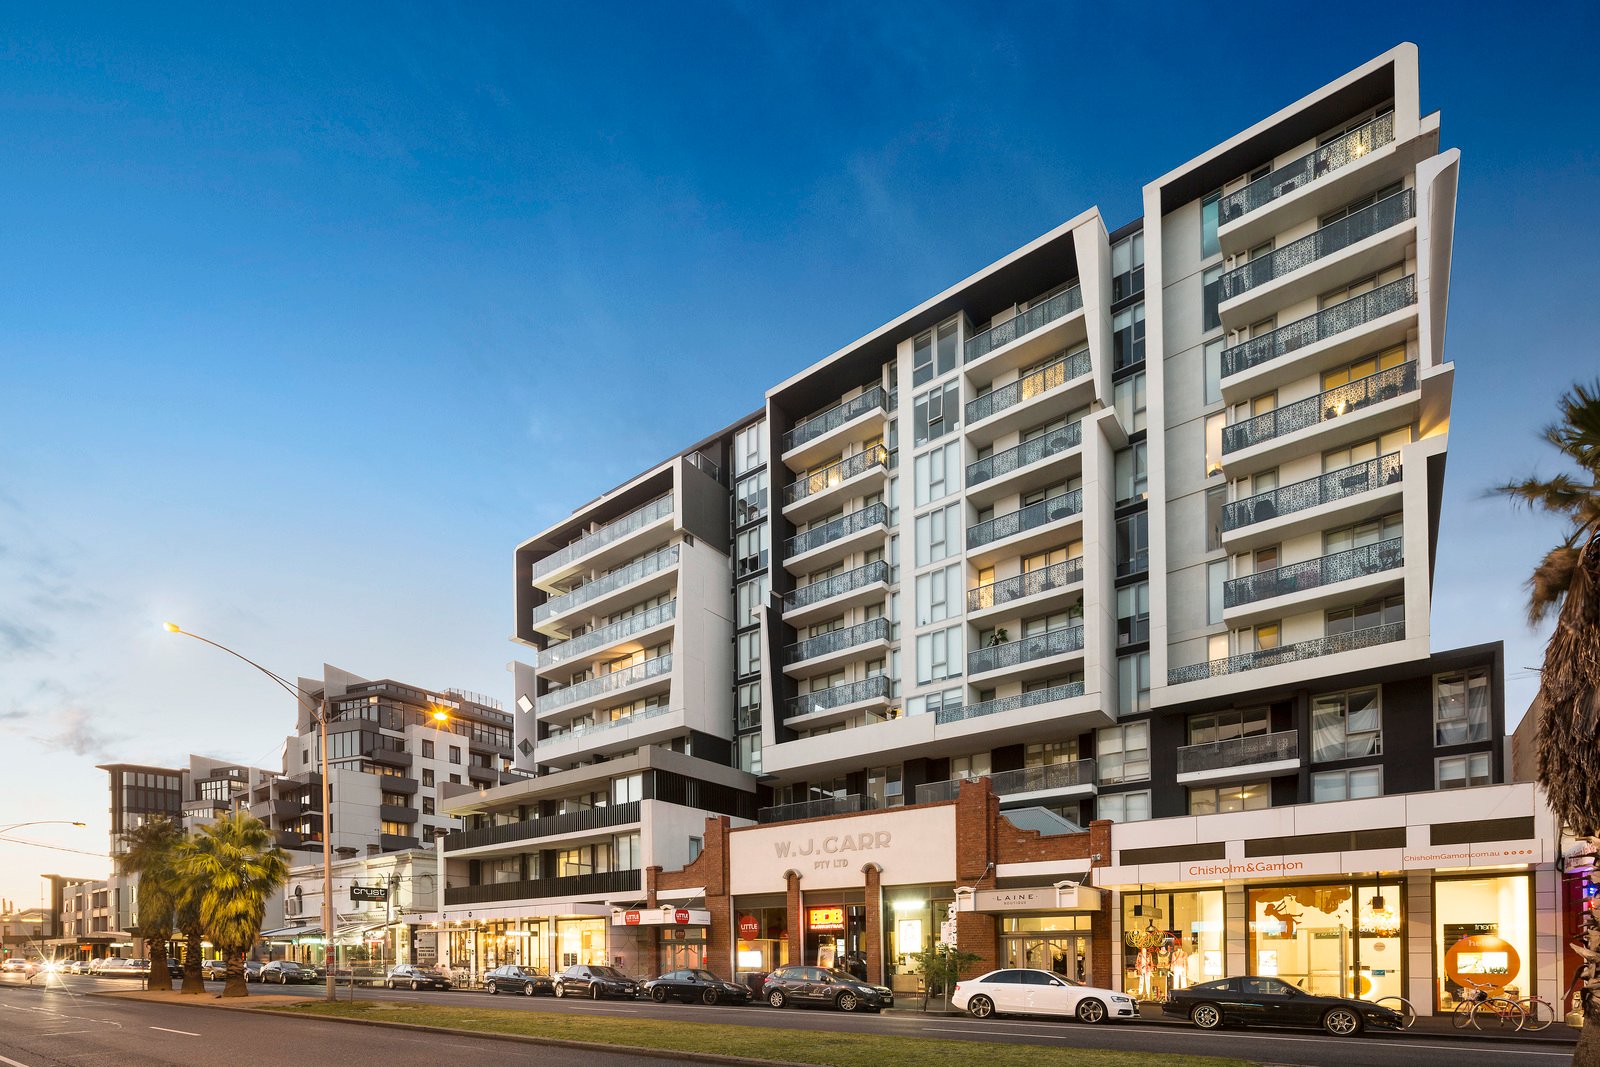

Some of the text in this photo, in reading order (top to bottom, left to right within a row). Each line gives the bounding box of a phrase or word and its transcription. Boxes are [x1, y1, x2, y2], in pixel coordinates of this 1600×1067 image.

[814, 858, 849, 870] PTY LTD
[1189, 861, 1303, 876] Chisholm&Gamon
[353, 888, 386, 896] crust
